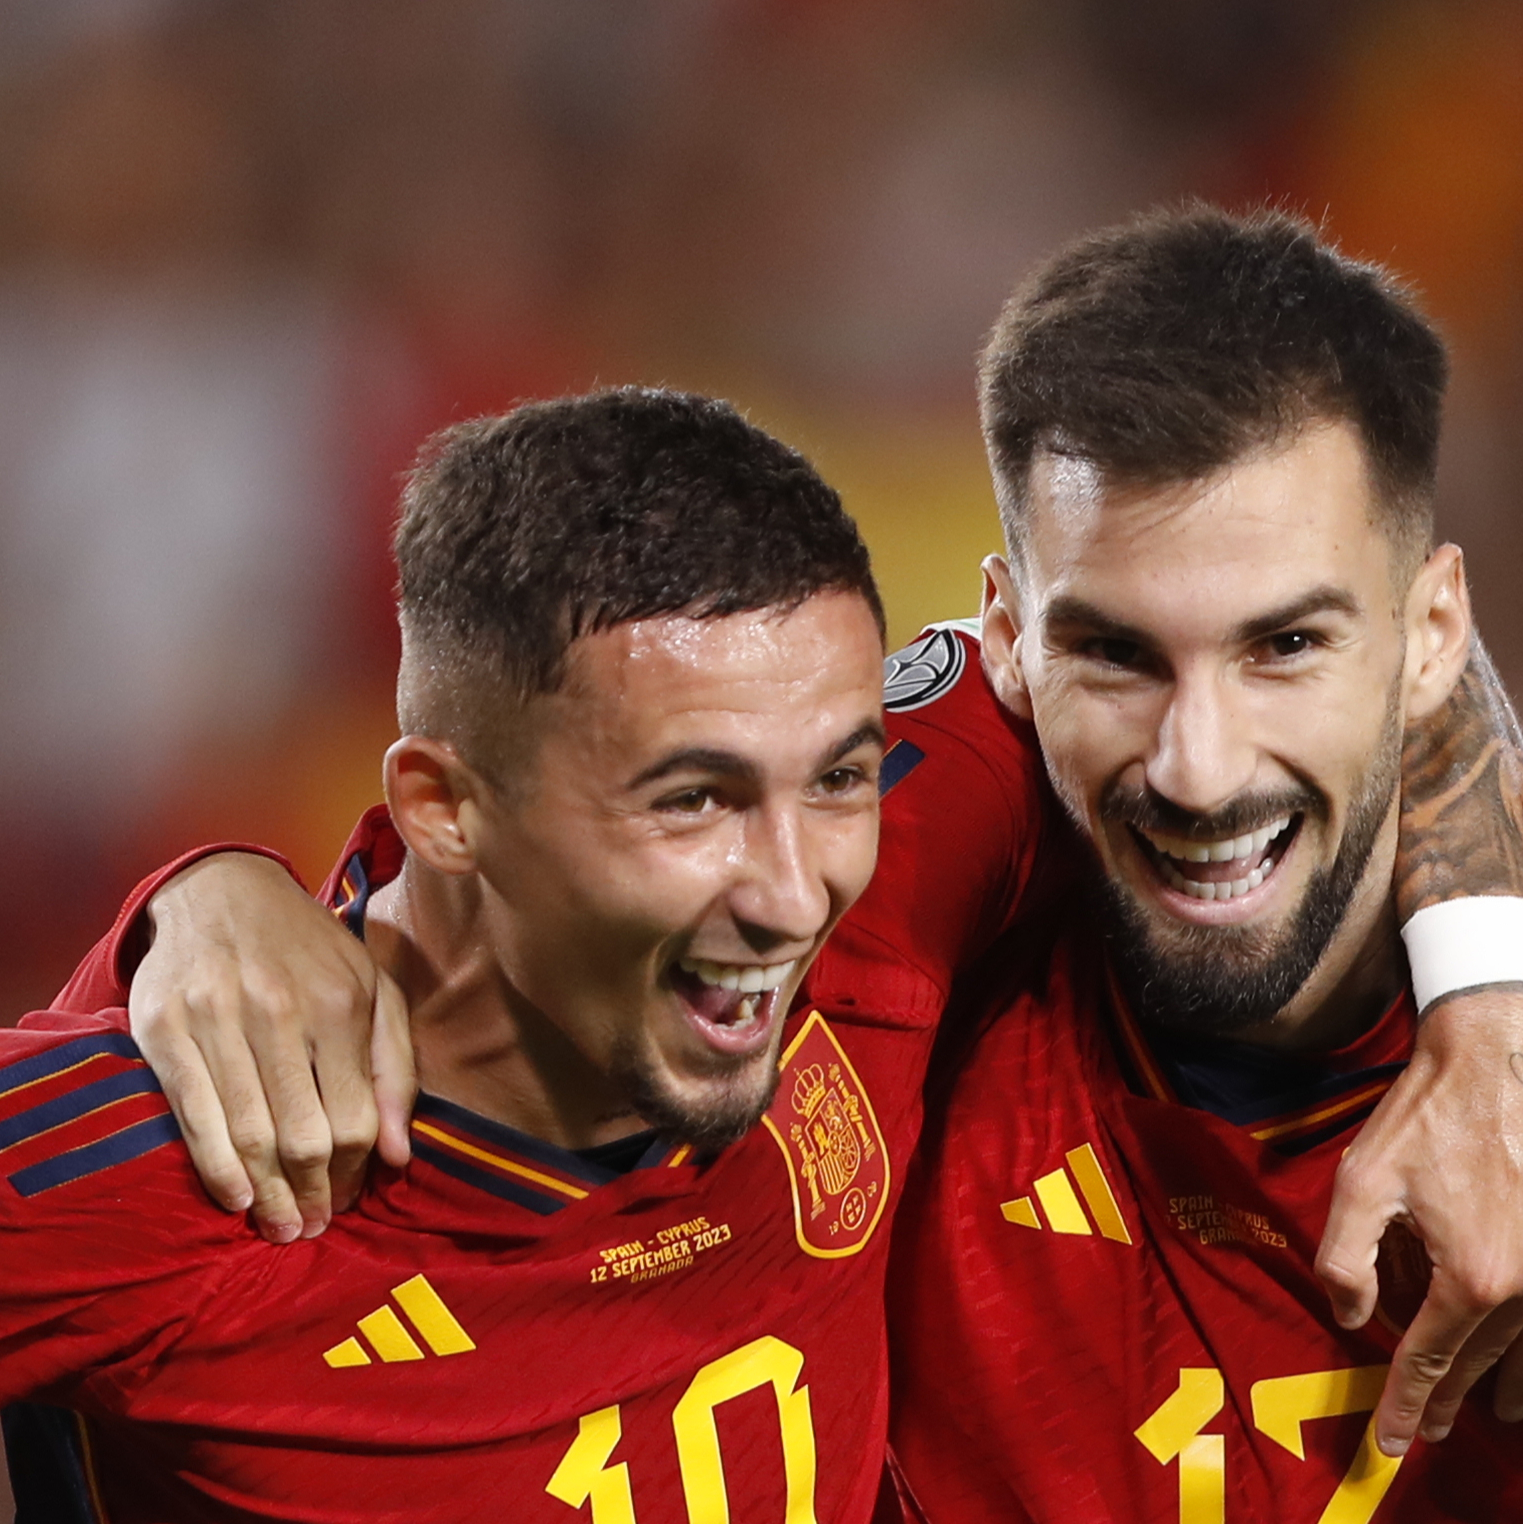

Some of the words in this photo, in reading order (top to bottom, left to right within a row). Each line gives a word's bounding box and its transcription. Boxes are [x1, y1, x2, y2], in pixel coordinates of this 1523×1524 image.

[1169, 1195, 1213, 1214] SPAIN
[590, 1265, 608, 1283] 12
[612, 1239, 691, 1278] SEPTEMBER
[693, 1223, 732, 1252] 2023
[599, 1239, 645, 1264] SPAIN
[656, 1216, 711, 1245] CYPRUS
